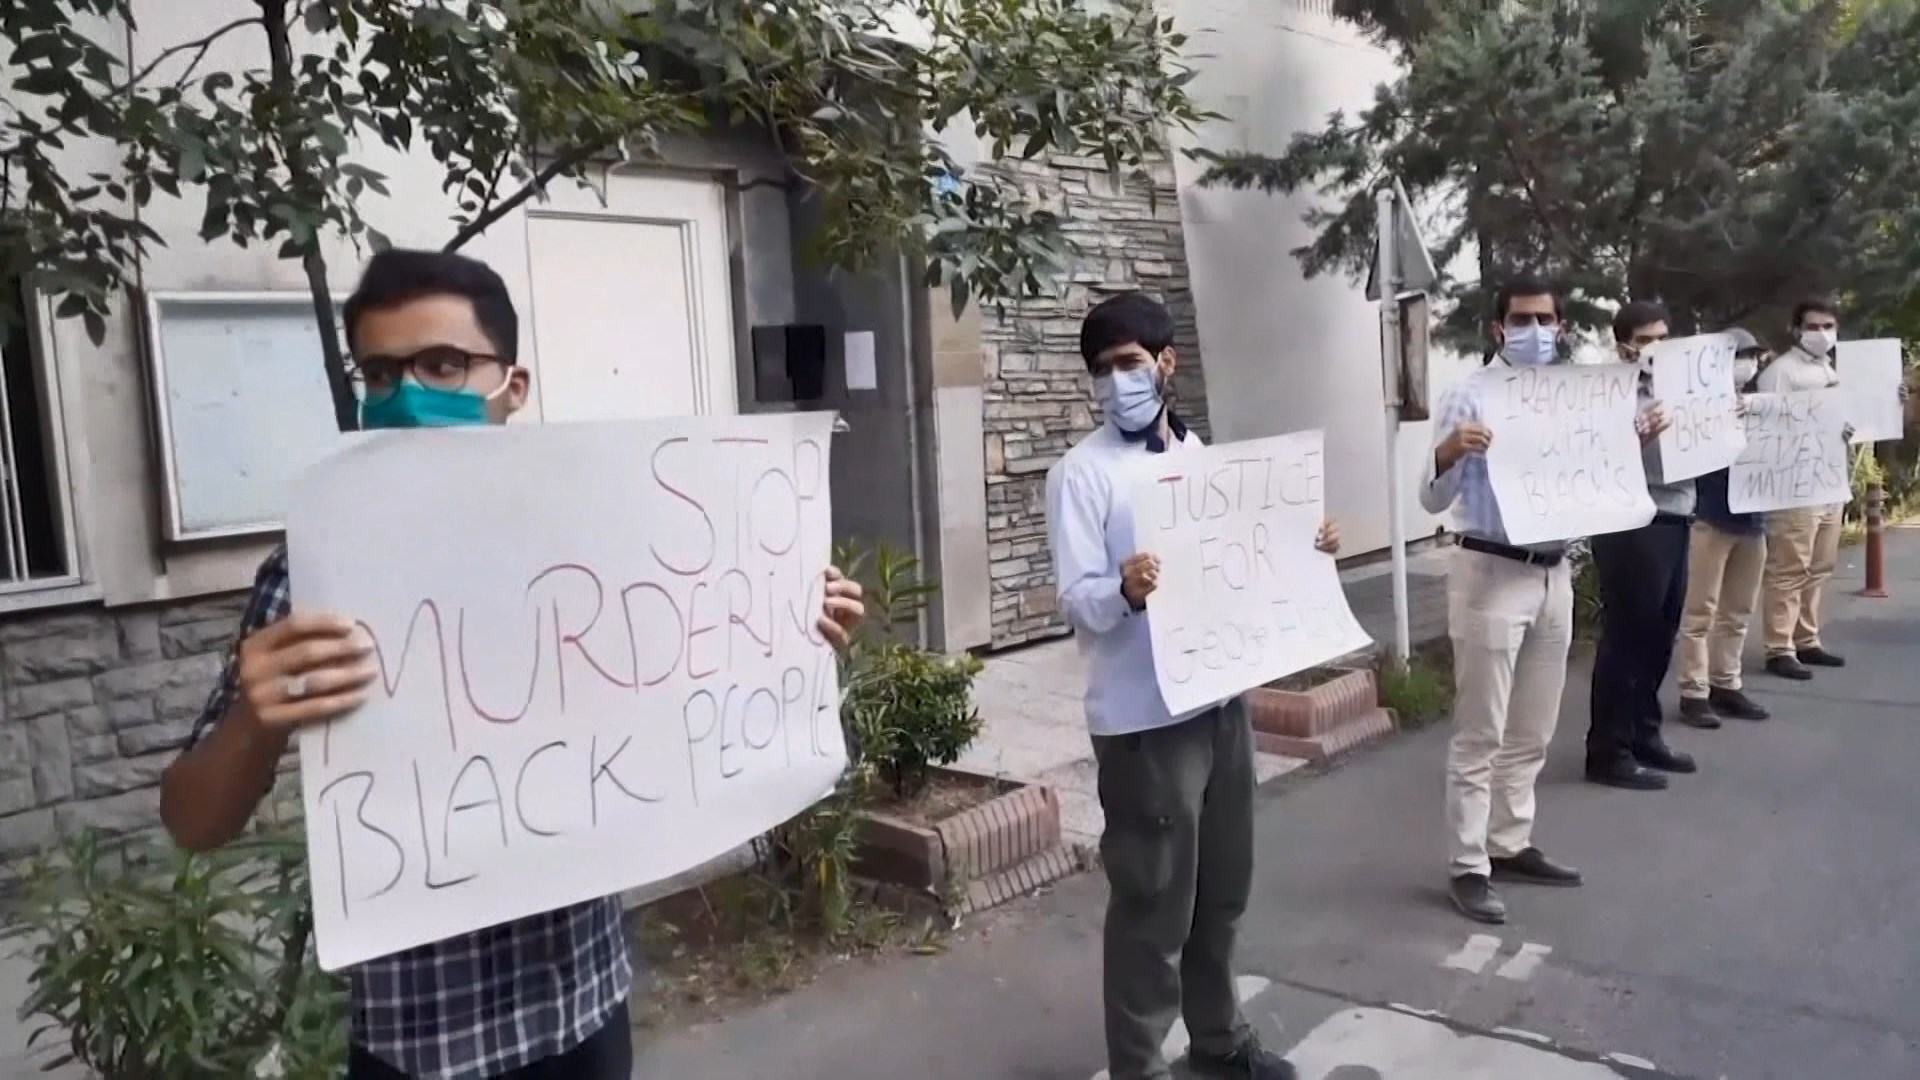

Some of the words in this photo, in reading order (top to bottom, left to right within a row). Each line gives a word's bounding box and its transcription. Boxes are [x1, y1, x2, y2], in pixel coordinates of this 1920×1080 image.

[650, 437, 821, 593] STOP
[1158, 451, 1320, 530] JUSTICE
[1736, 460, 1842, 504] MATTERS
[1200, 522, 1276, 593] FOR
[319, 734, 661, 919] BLACK
[683, 653, 832, 807] PEOPLE
